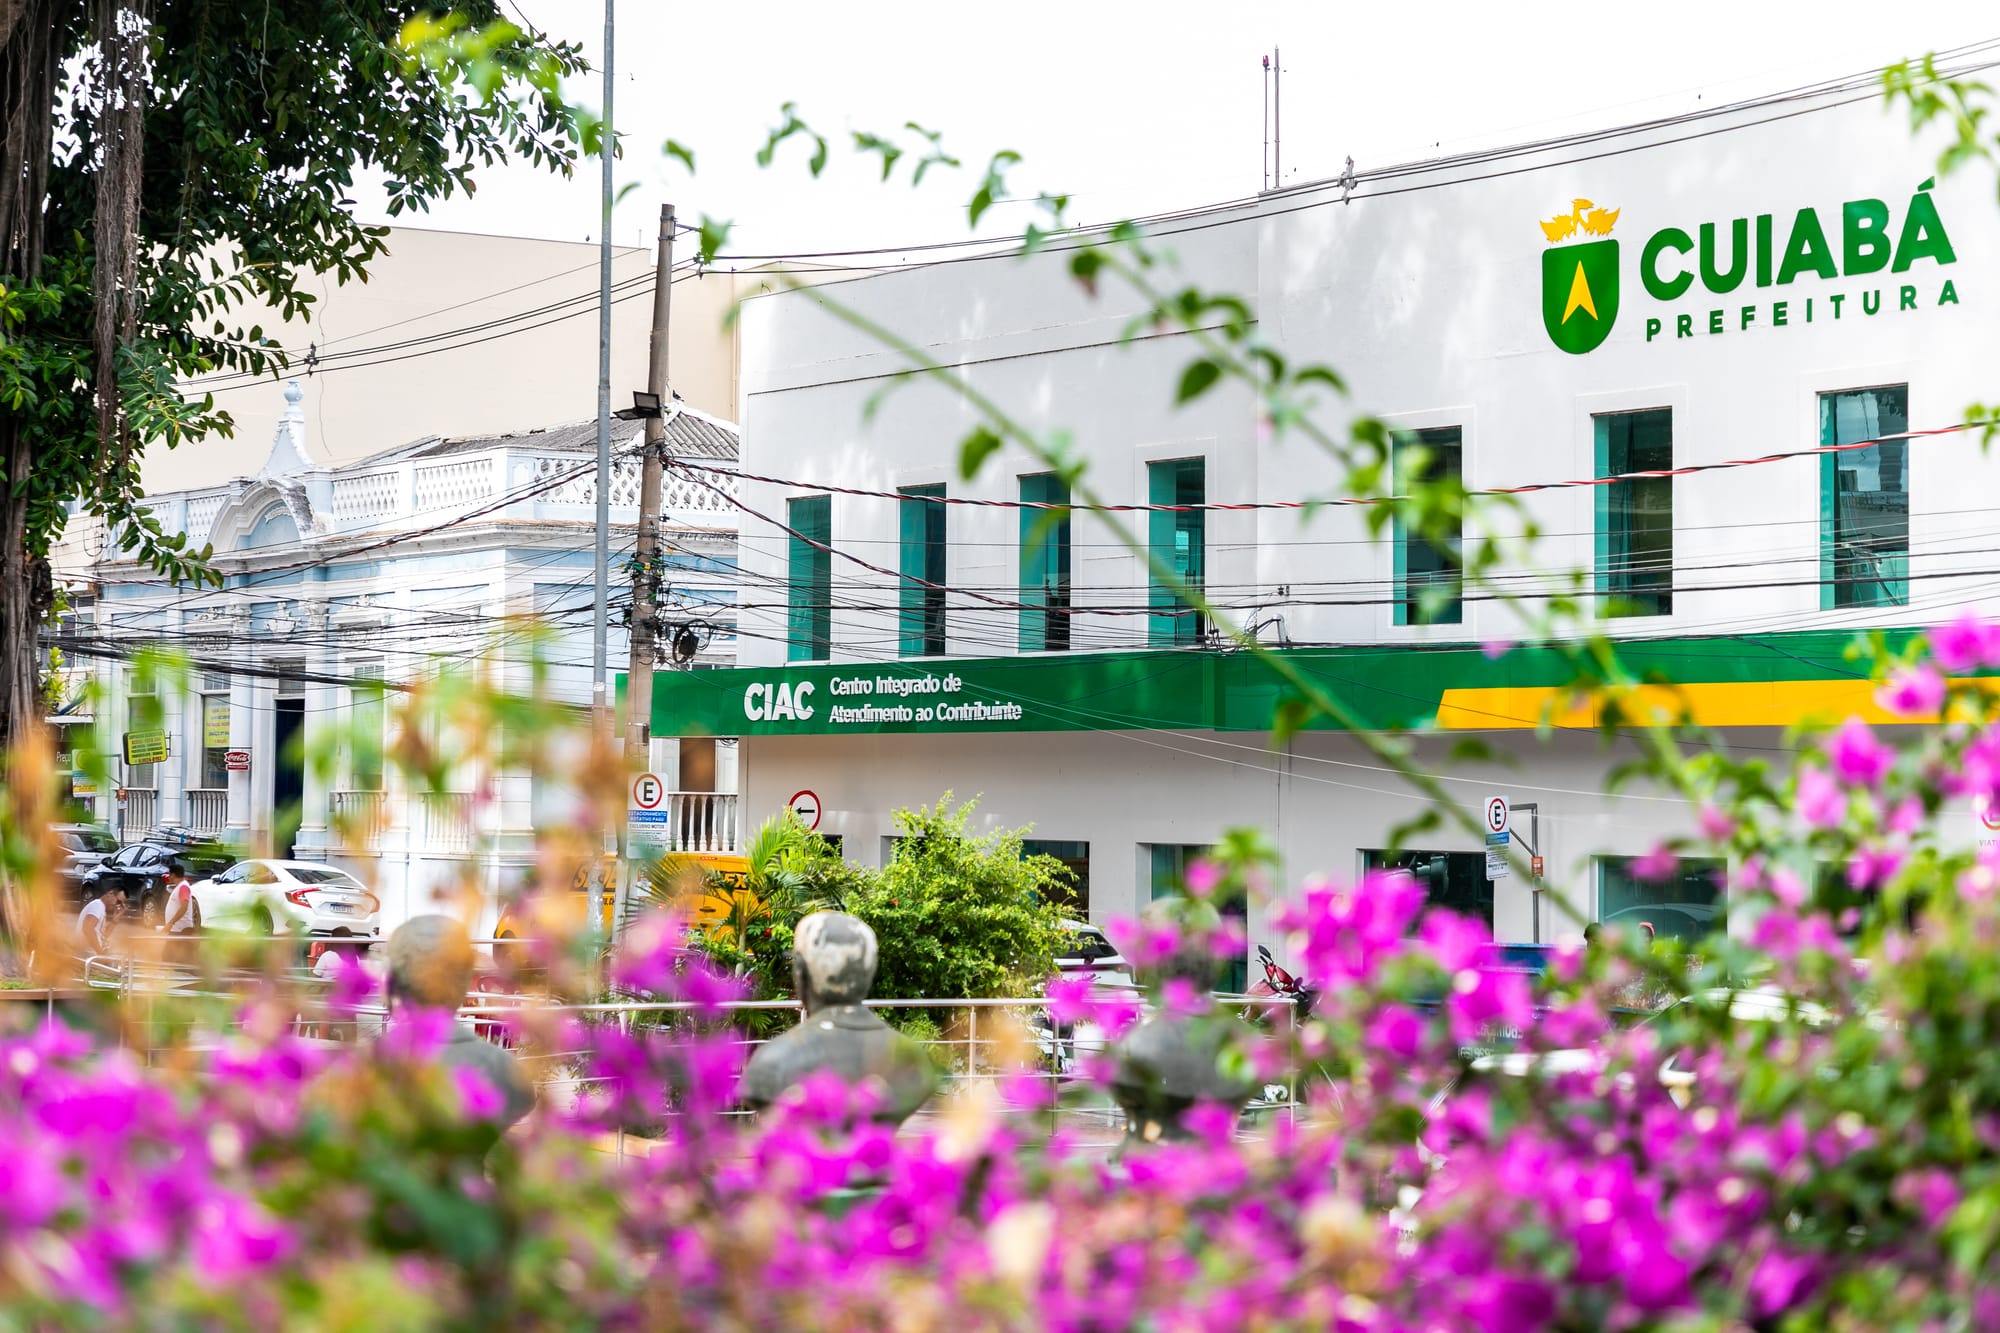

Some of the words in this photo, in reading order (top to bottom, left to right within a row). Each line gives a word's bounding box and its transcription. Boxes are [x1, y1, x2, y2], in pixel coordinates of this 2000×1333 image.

[1640, 177, 1958, 301] CUIABÁ
[1646, 280, 1959, 342] PREFEITURA
[829, 677, 873, 696] Centro
[876, 674, 940, 698] Integrado
[942, 673, 962, 693] de
[744, 681, 815, 721] CIAC
[828, 703, 914, 723] Atendimento
[915, 707, 935, 722] ao
[936, 700, 1023, 721] Contribuinte
[643, 781, 654, 802] E
[1494, 805, 1502, 825] E
